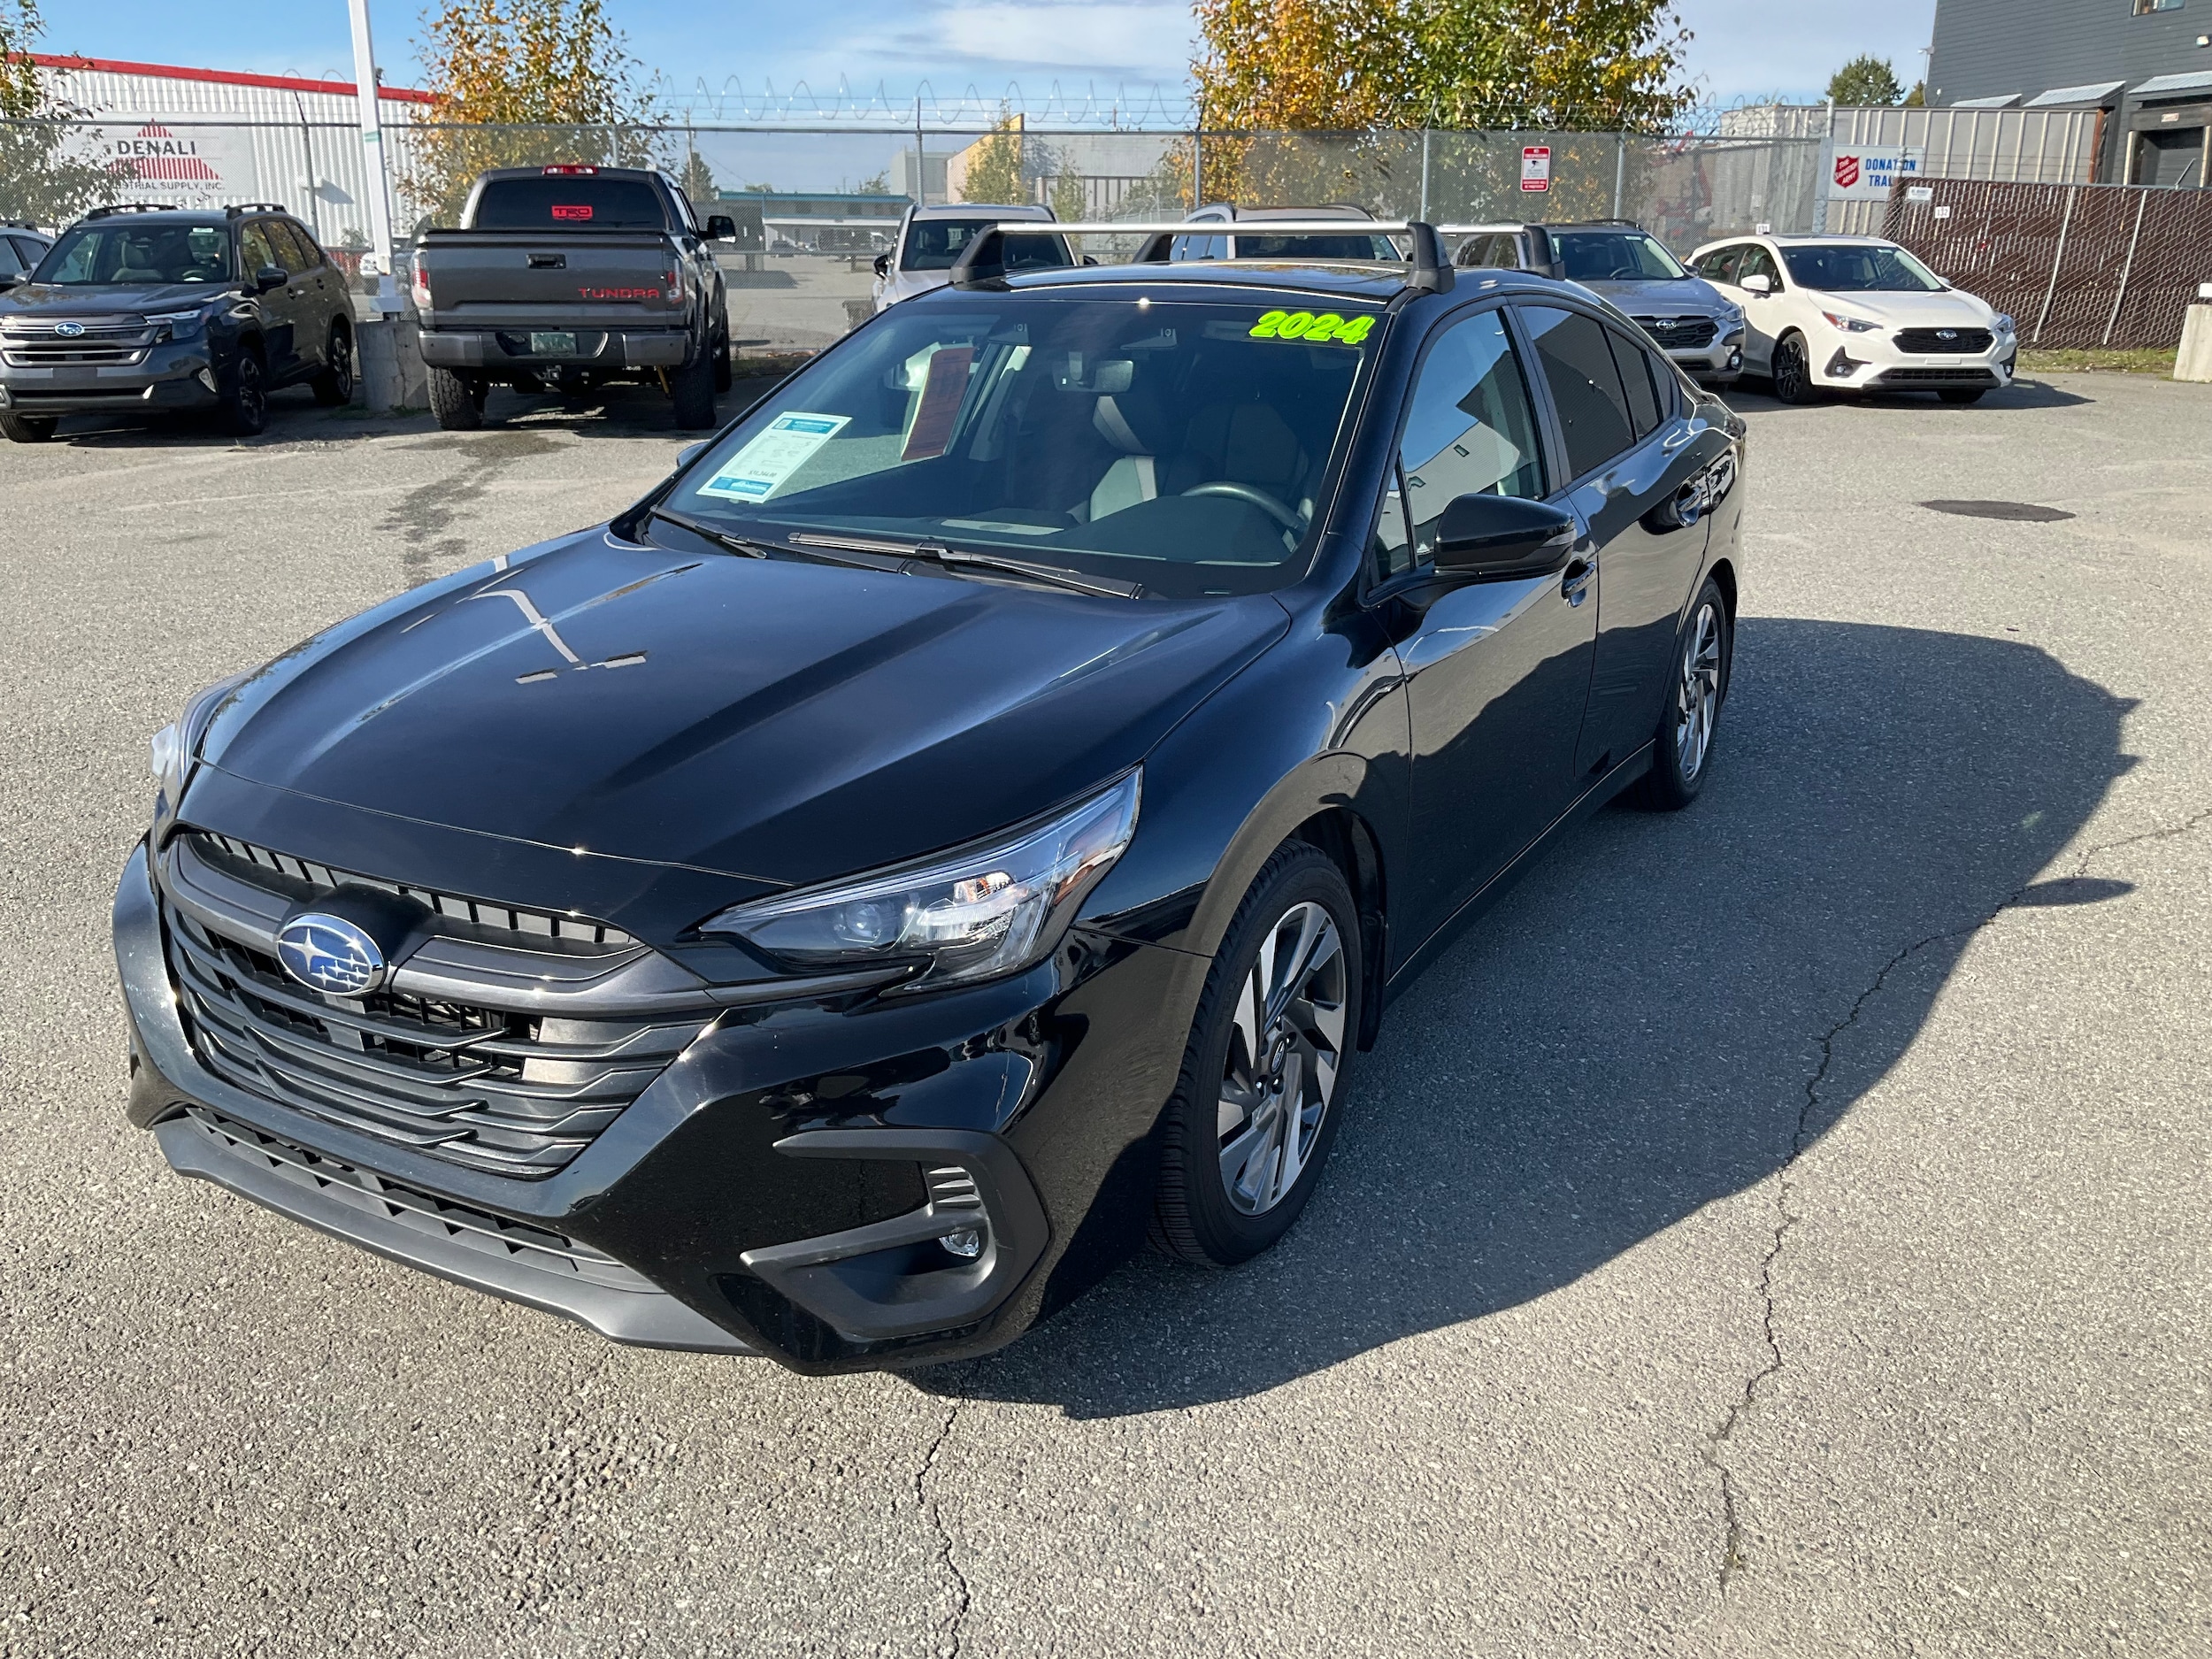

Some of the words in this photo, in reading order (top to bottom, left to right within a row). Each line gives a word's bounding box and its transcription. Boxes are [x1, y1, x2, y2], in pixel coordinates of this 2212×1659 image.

[117, 140, 196, 155] DENALI
[1865, 157, 1916, 171] DONATON
[205, 182, 226, 191] INC.
[578, 288, 660, 298] TUNDRA
[1248, 311, 1376, 345] 2024
